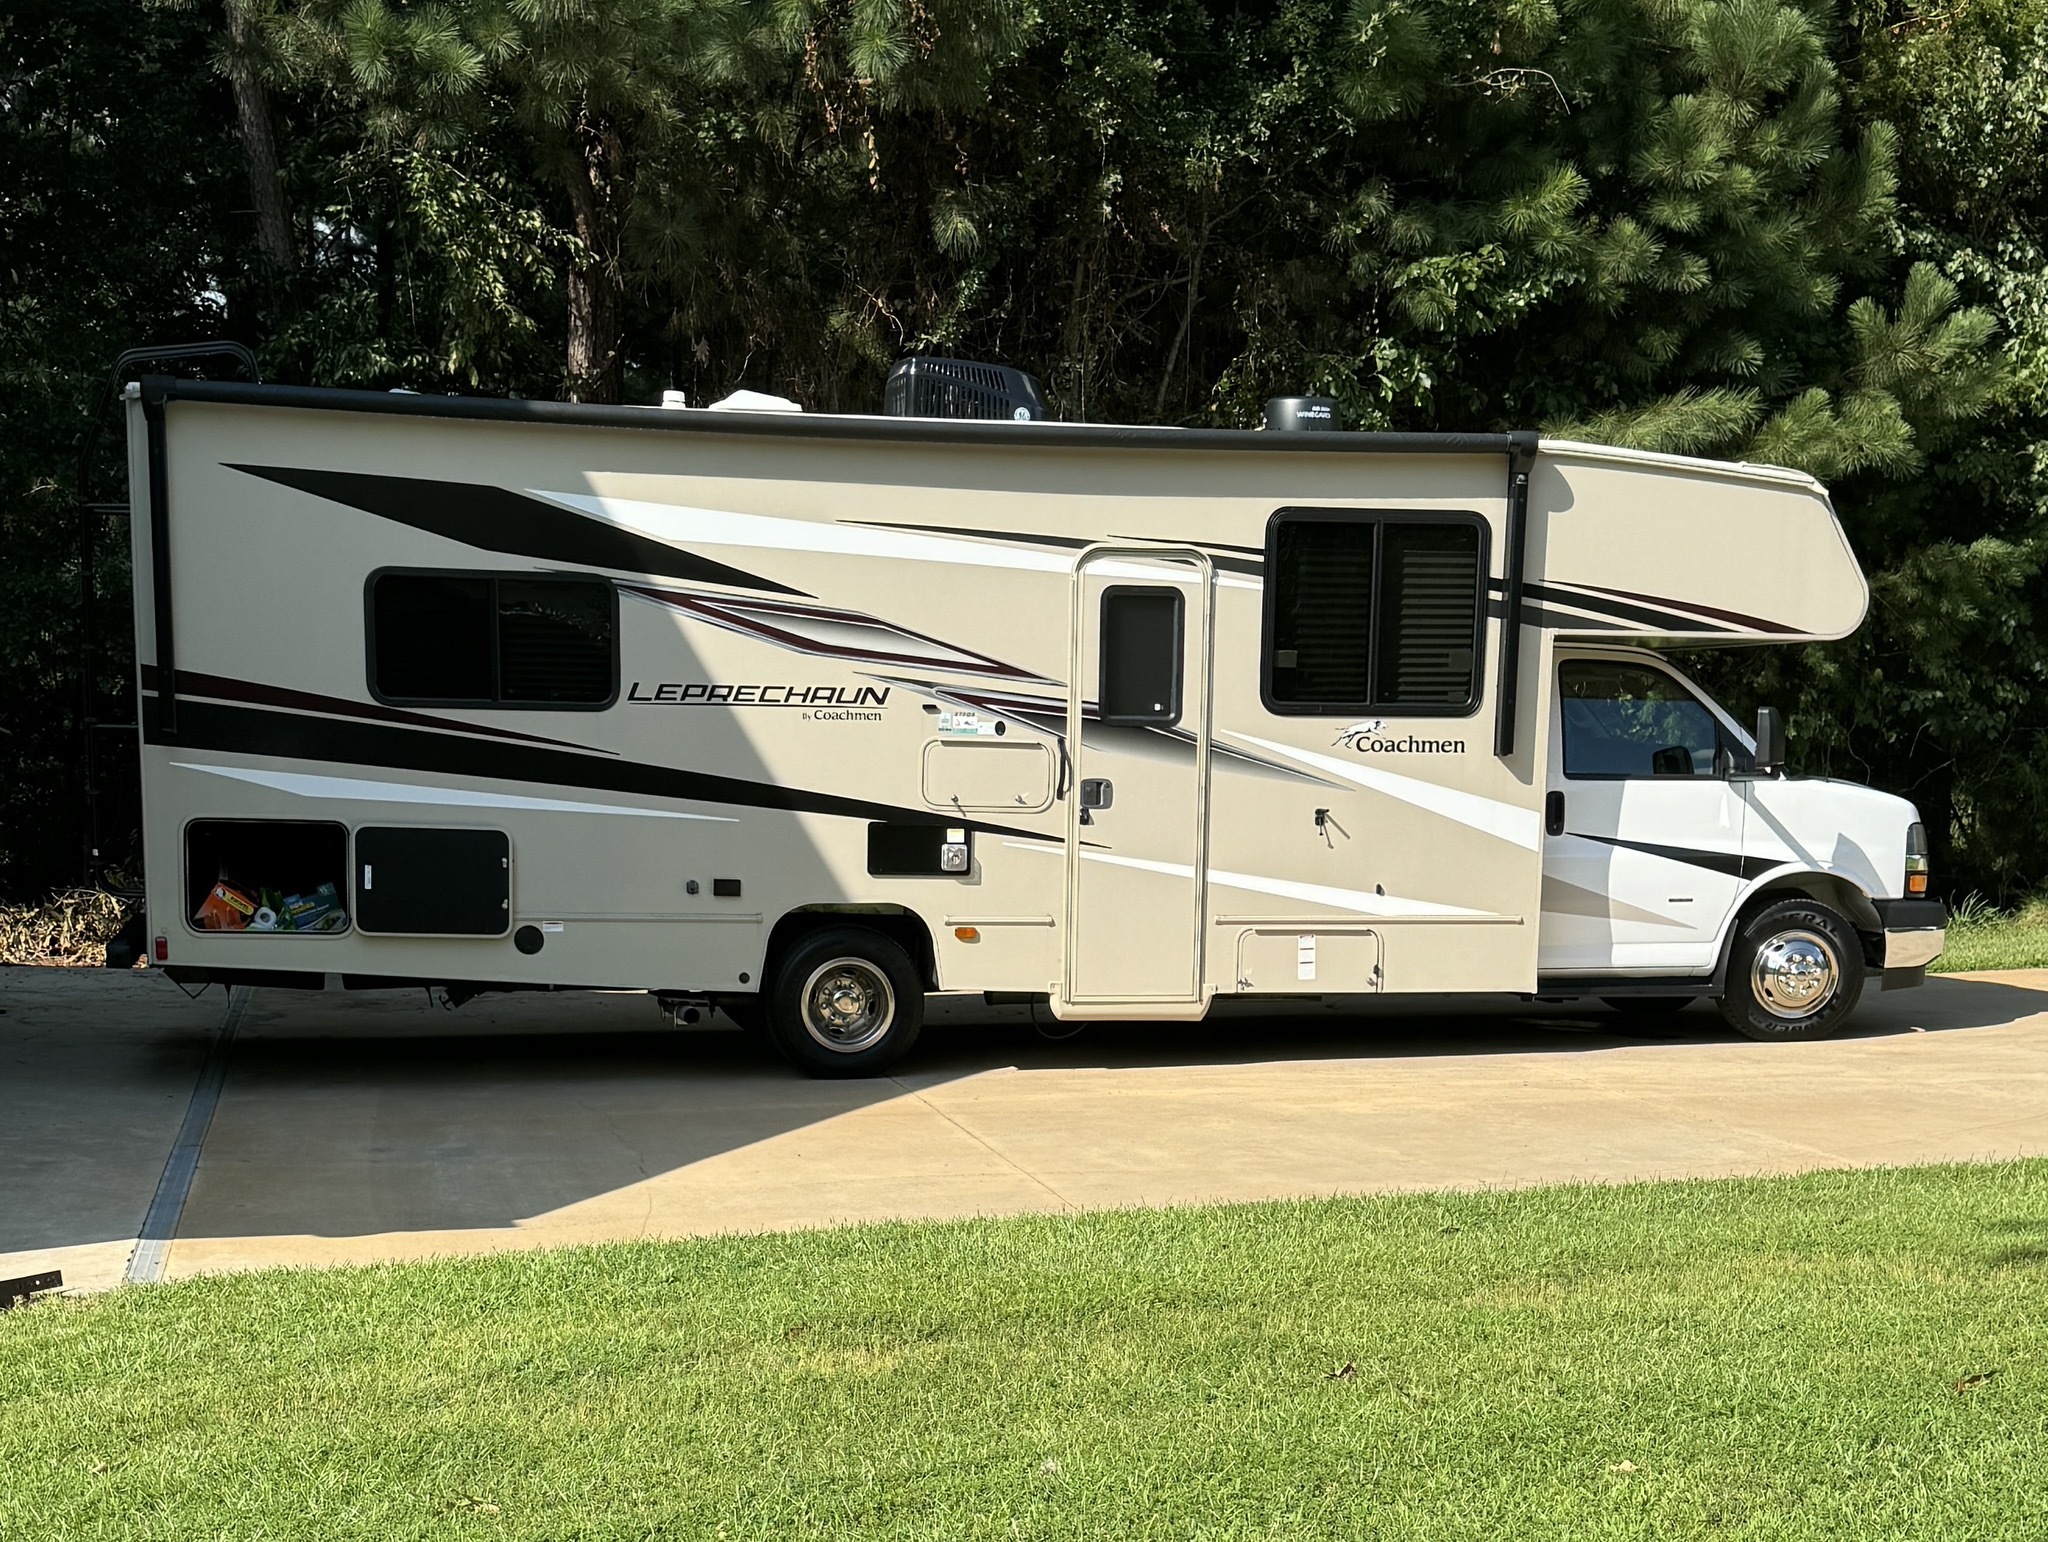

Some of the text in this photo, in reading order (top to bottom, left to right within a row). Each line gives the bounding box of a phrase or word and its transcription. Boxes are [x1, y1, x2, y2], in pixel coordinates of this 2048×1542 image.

[627, 682, 891, 705] LEPRECHAUN
[814, 709, 882, 721] Coachmen
[1356, 735, 1466, 754] Coachmen
